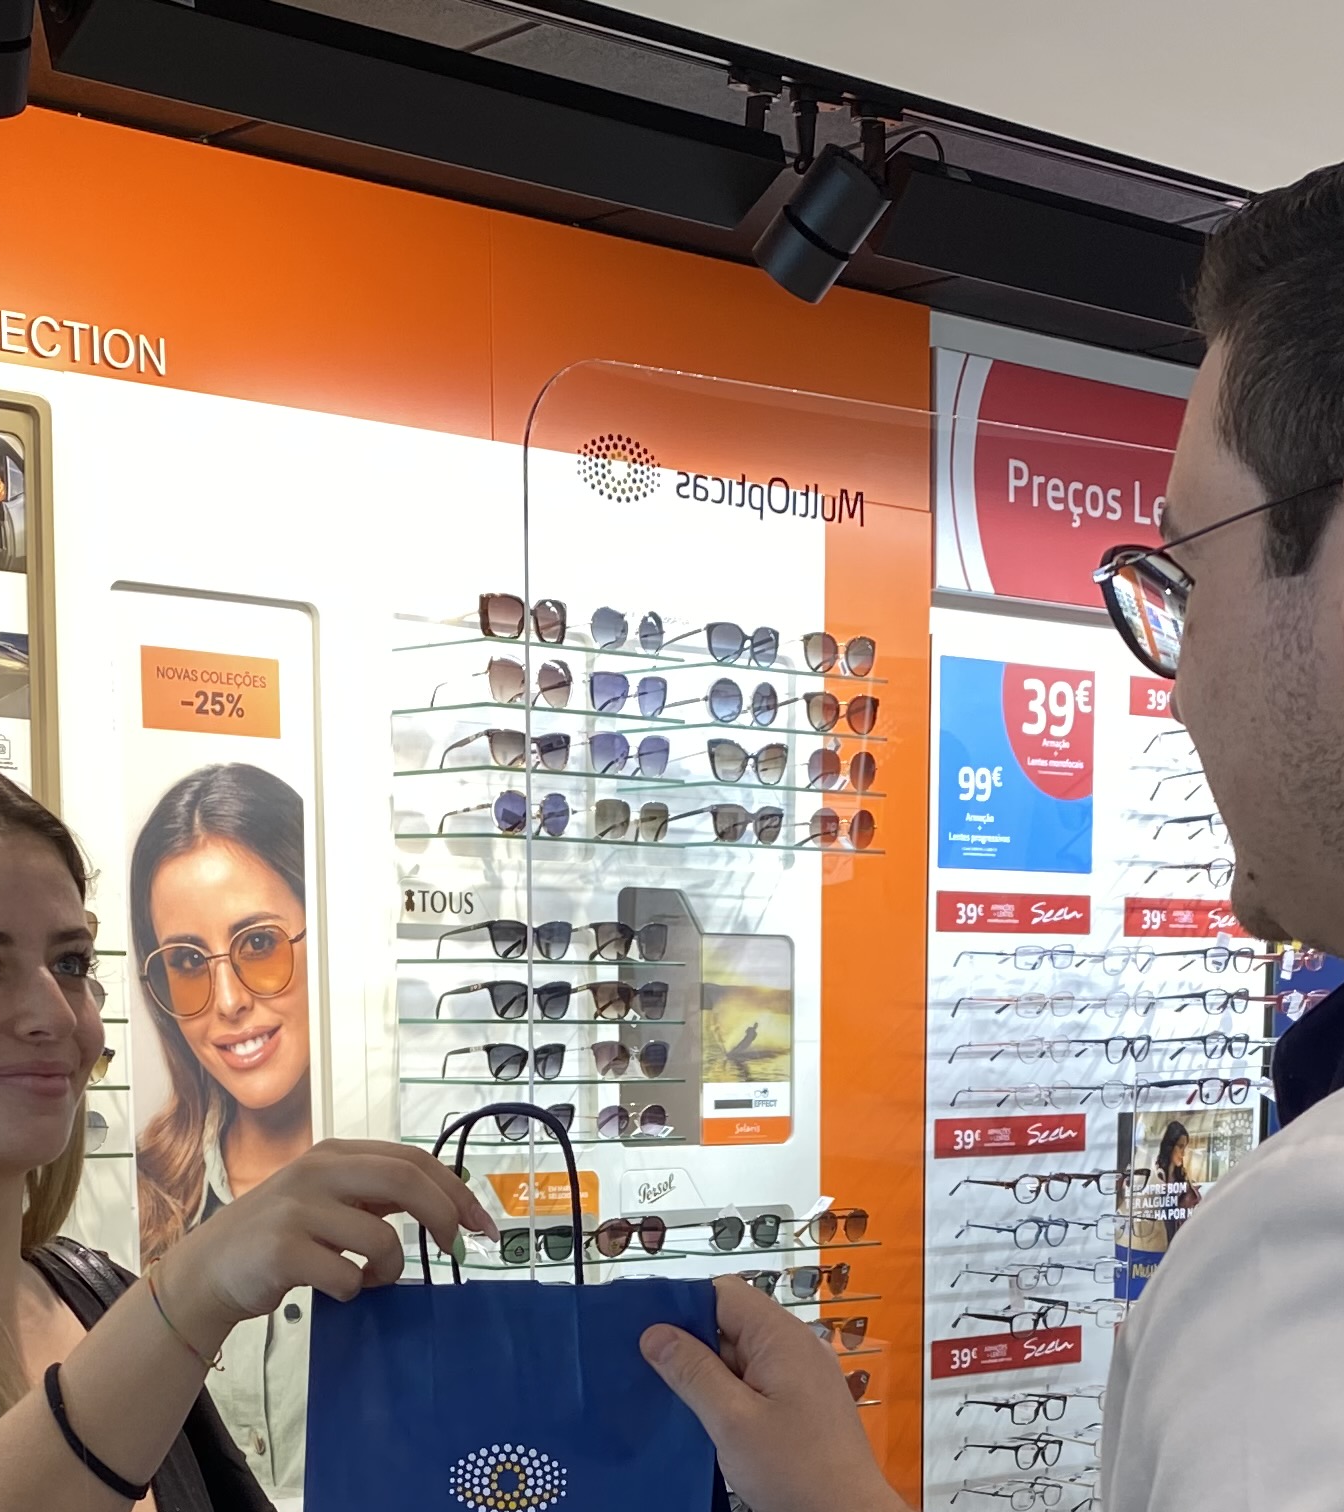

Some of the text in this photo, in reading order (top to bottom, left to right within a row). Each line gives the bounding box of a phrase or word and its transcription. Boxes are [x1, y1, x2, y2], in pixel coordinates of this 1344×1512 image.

[1008, 458, 1122, 528] Preços
[156, 665, 267, 689] NOVAS COLEÇÕES
[180, 689, 245, 719] -25%
[1022, 678, 1093, 737] 39€
[958, 766, 1003, 802] 99€
[417, 890, 474, 915] TOUS
[956, 902, 985, 925] 39€
[1141, 909, 1167, 930] 39€
[953, 1129, 982, 1151] 39€
[637, 1172, 677, 1204] Persol
[1167, 1182, 1187, 1194] BOM
[1168, 1207, 1186, 1220] POR
[950, 1347, 978, 1370] 39€
